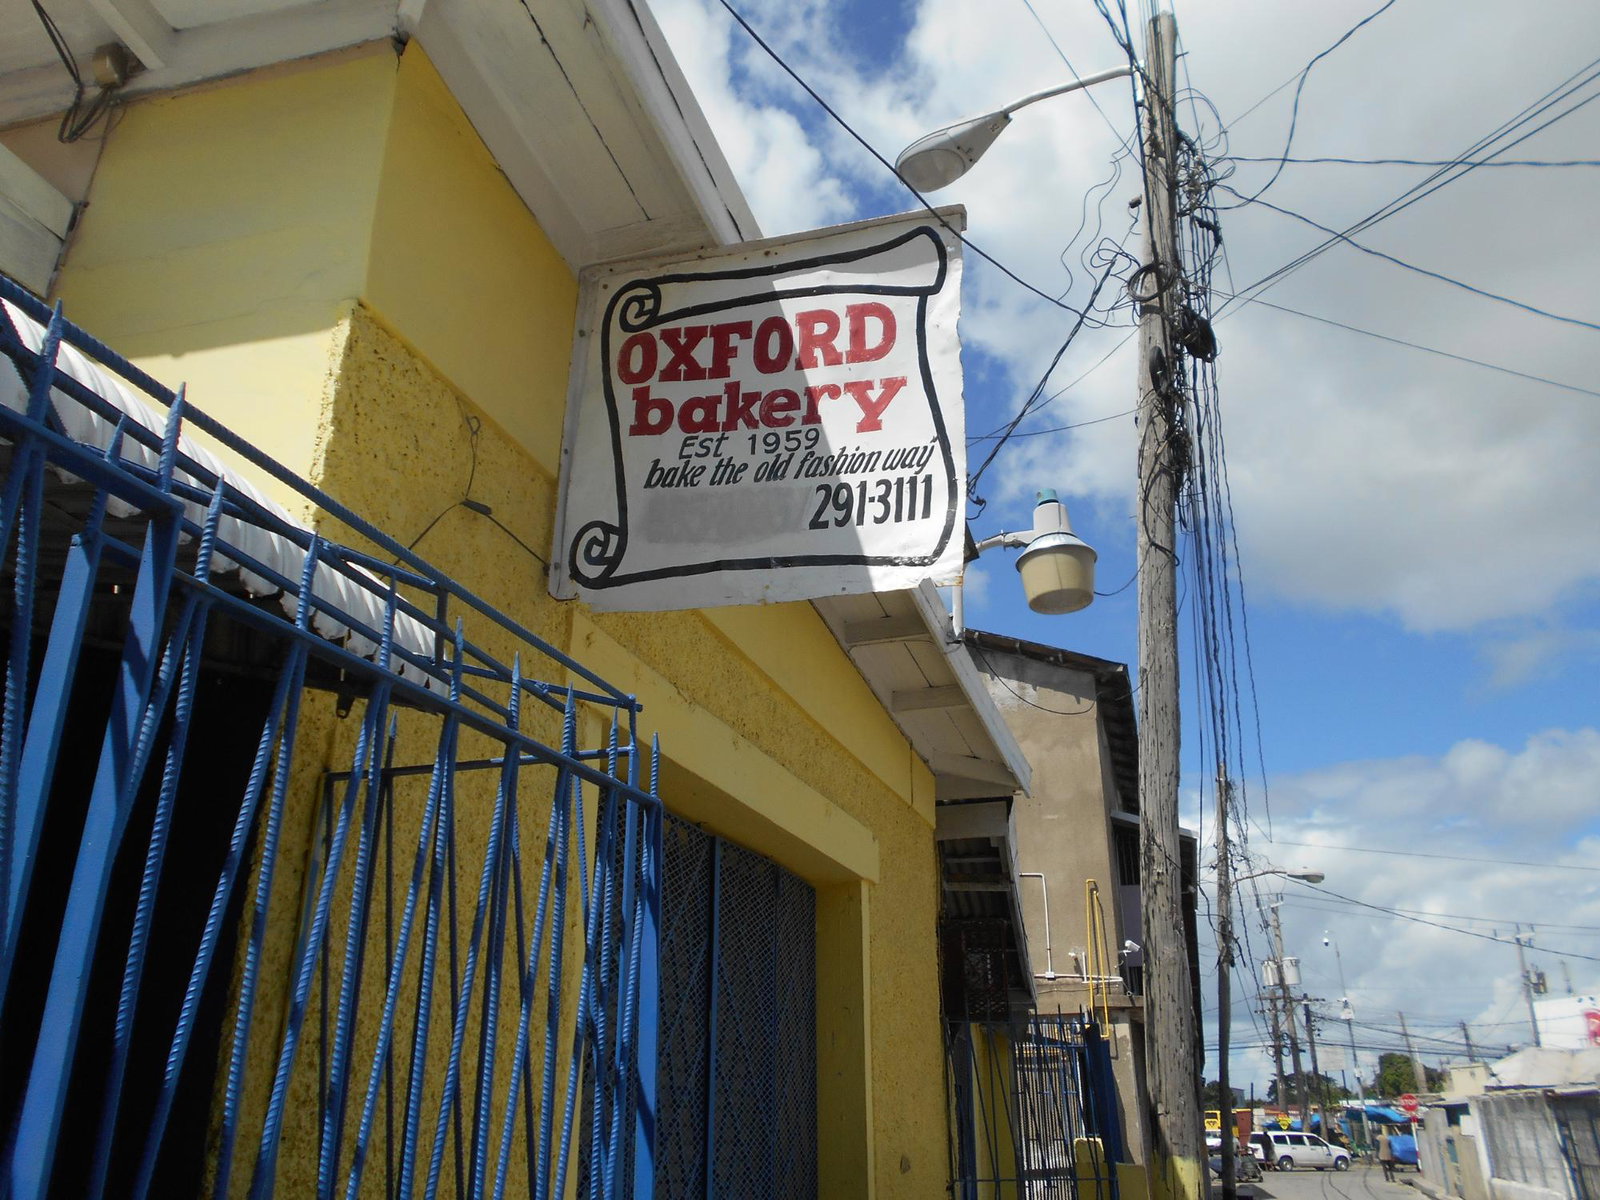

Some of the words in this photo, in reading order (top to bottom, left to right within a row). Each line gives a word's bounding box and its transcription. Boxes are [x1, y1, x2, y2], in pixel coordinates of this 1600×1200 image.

[617, 302, 896, 385] OXFORD
[644, 460, 706, 488] bake
[710, 457, 749, 486] the
[754, 450, 790, 479] old
[794, 447, 883, 479] fashion
[679, 432, 729, 459] Est
[749, 428, 819, 455] 1959
[809, 474, 932, 530] 291-3111
